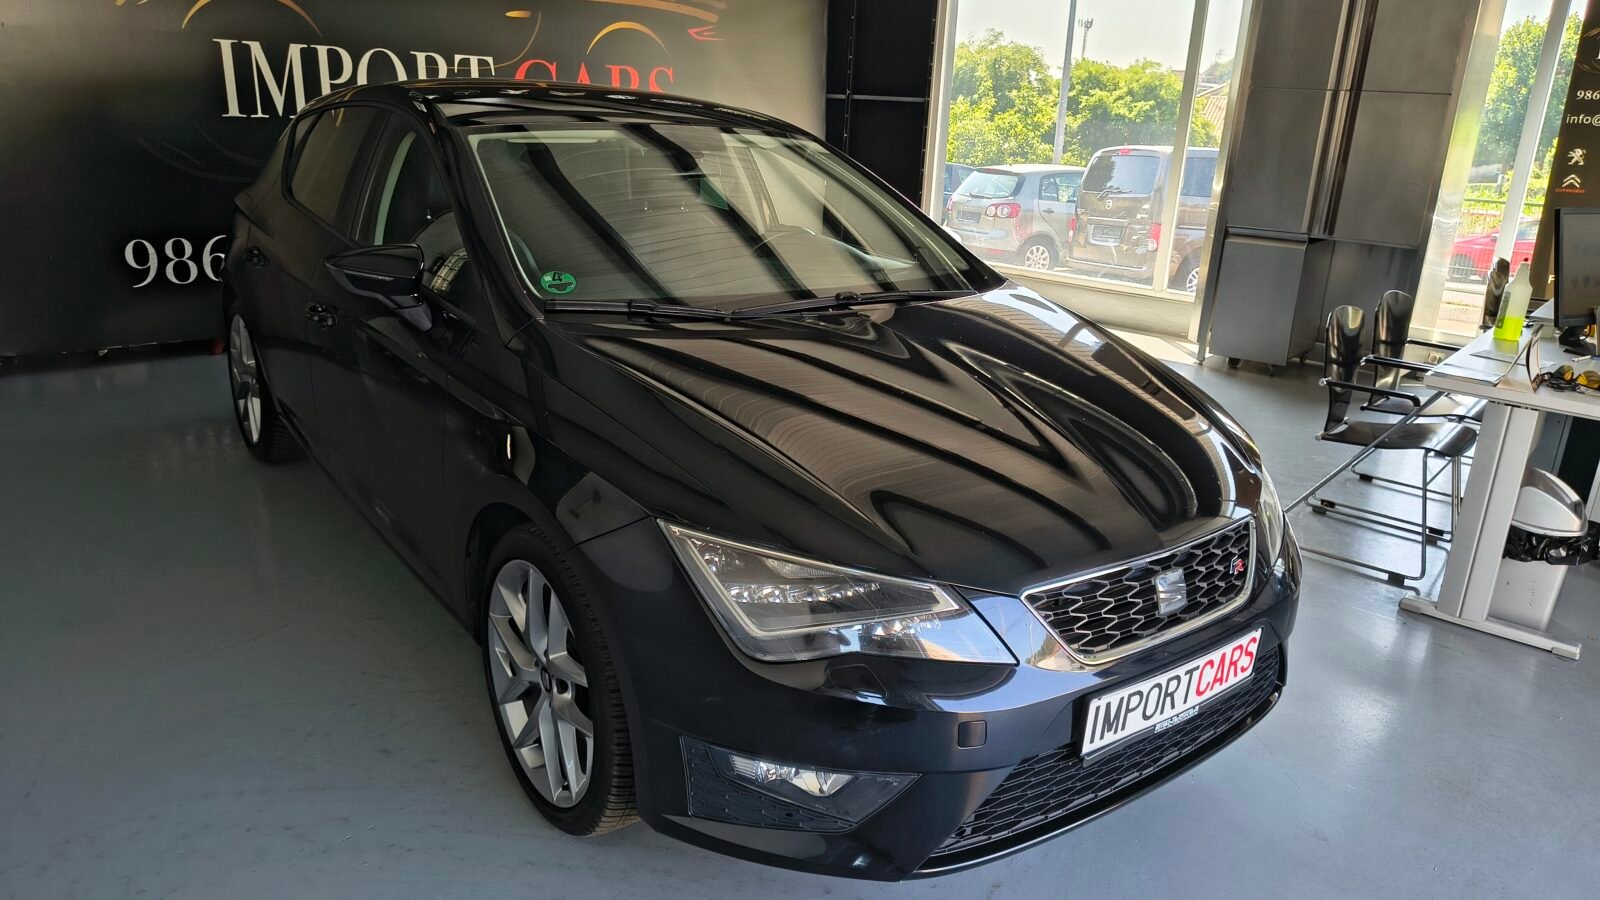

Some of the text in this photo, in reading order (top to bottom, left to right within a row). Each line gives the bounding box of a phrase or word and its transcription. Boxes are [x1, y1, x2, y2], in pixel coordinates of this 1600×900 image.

[1576, 90, 1600, 100] 986
[124, 235, 227, 289] 986
[1089, 636, 1258, 744] IMPORTCARS
